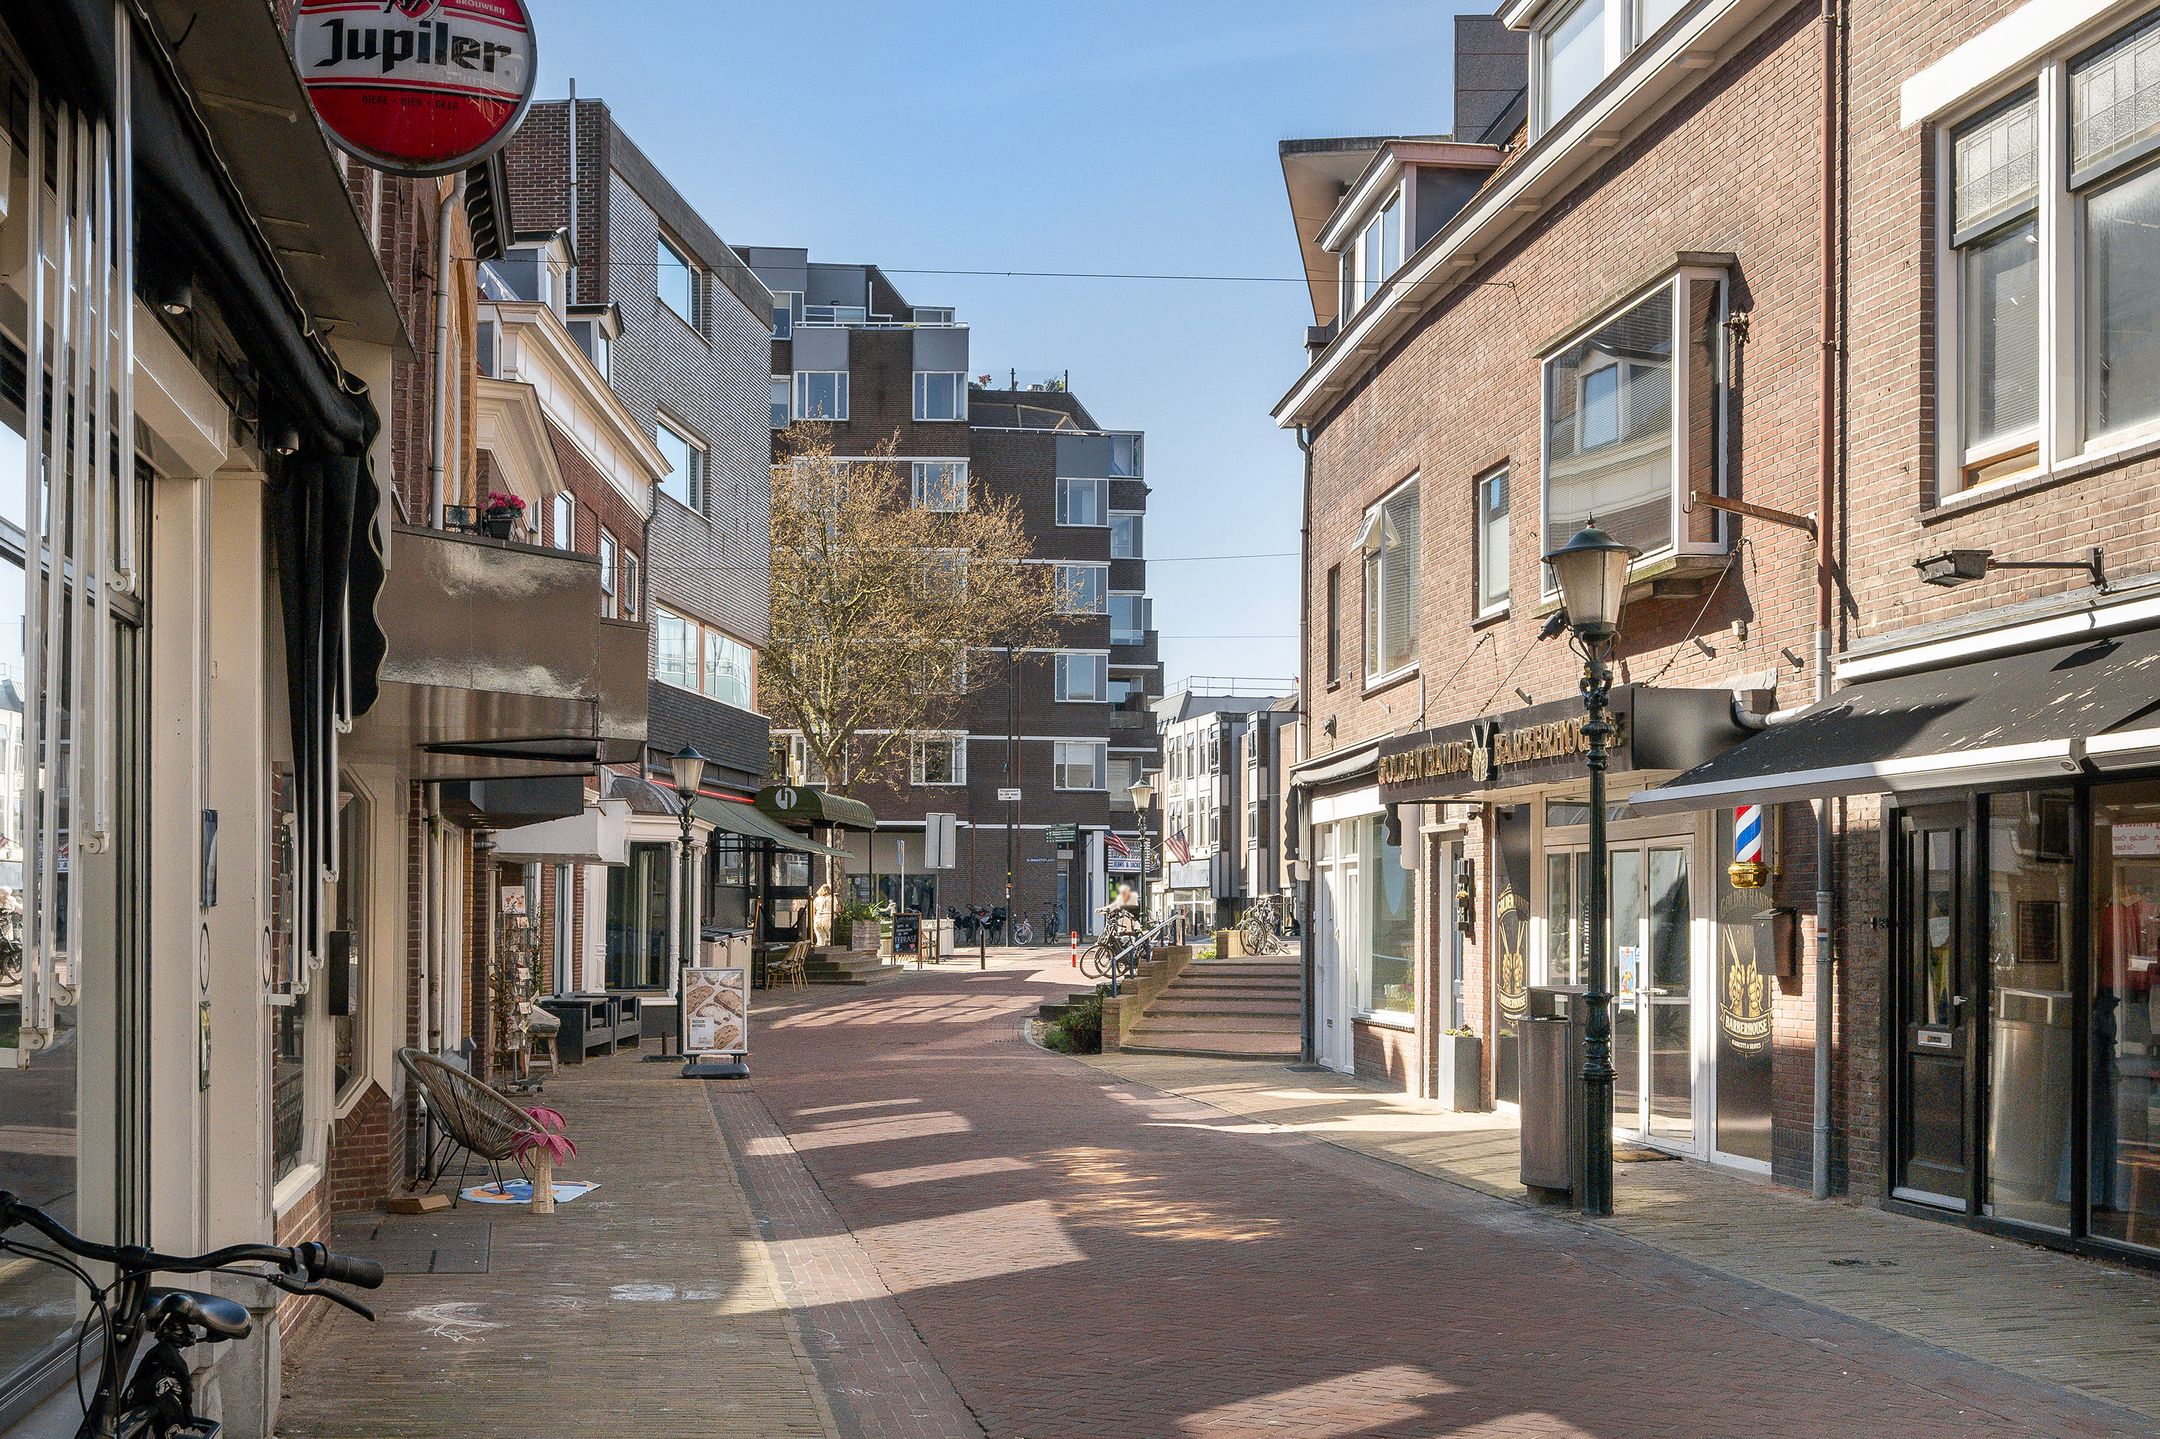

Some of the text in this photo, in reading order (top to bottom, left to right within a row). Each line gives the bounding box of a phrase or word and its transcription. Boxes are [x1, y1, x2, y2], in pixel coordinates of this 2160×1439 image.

[313, 18, 512, 74] Jupiler
[1378, 749, 1425, 785] GOLDEN
[1725, 1014, 1768, 1036] BARBERHOUSE
